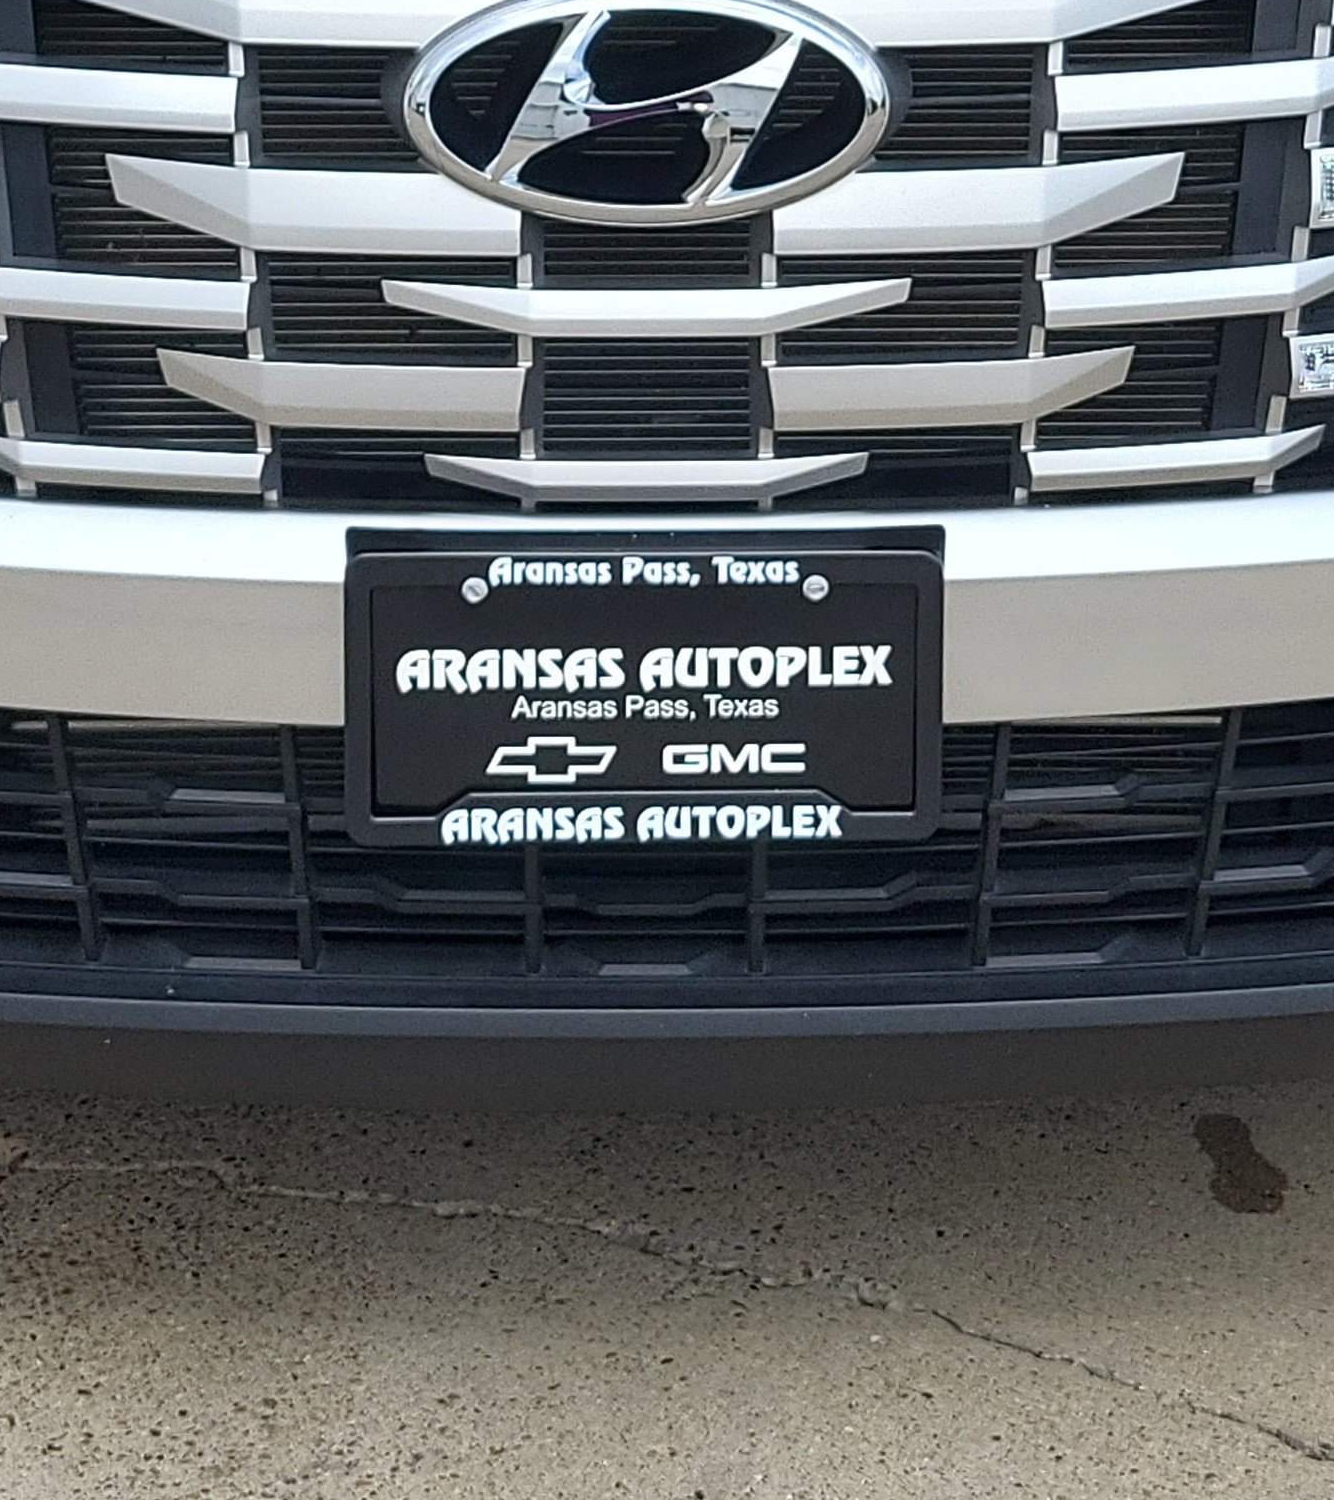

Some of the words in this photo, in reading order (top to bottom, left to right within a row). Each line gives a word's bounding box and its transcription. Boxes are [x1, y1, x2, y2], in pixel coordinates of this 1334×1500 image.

[487, 556, 613, 586] Aransas
[621, 556, 701, 587] Pass,
[711, 556, 800, 584] Texas
[395, 648, 625, 694] ARANSAS
[639, 645, 893, 692] AUTOPLEX
[511, 696, 618, 720] Aransas
[625, 696, 697, 720] Pass,
[703, 694, 779, 718] Texas
[661, 742, 807, 774] GMC
[441, 808, 625, 845] ARANSAS
[636, 804, 842, 843] AUTOPLEX
